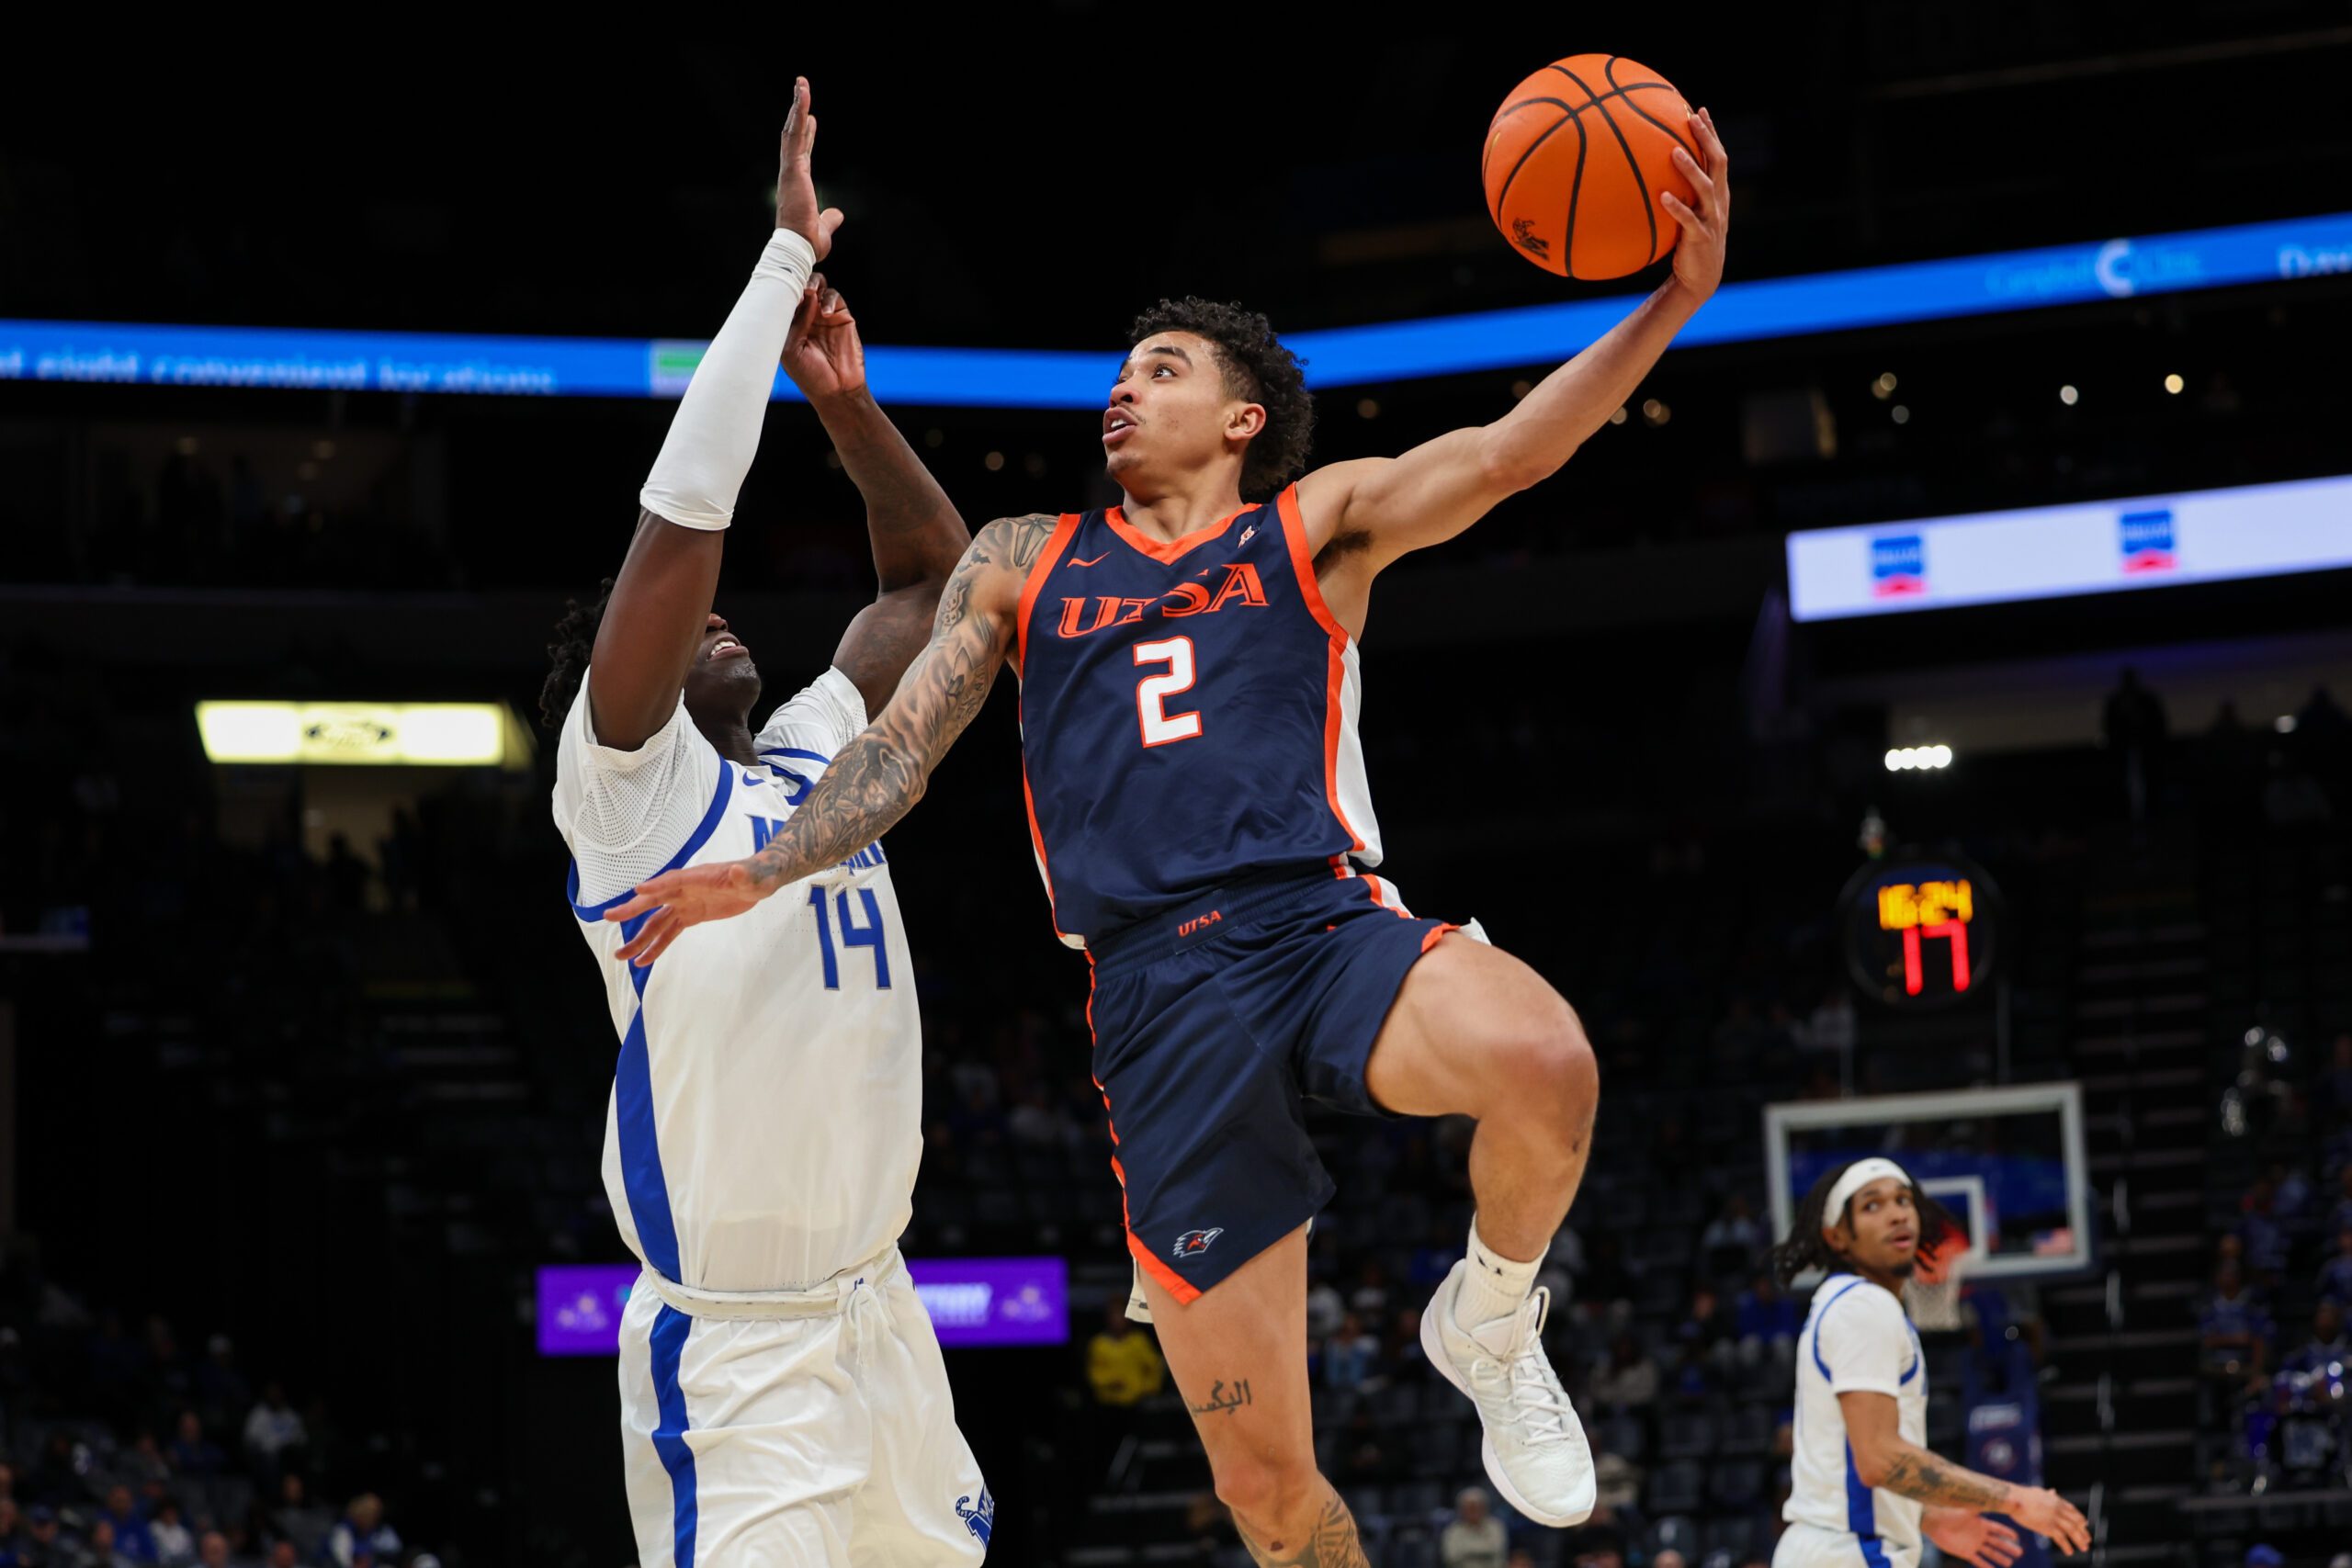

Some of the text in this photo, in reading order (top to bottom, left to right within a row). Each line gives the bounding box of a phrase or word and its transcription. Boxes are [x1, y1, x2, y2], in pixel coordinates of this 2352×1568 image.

[1057, 563, 1270, 638] UTSA
[1133, 635, 1203, 748] 2
[807, 884, 891, 990] 14
[1178, 910, 1223, 937] UTSA
[1903, 918, 1971, 997] 17
